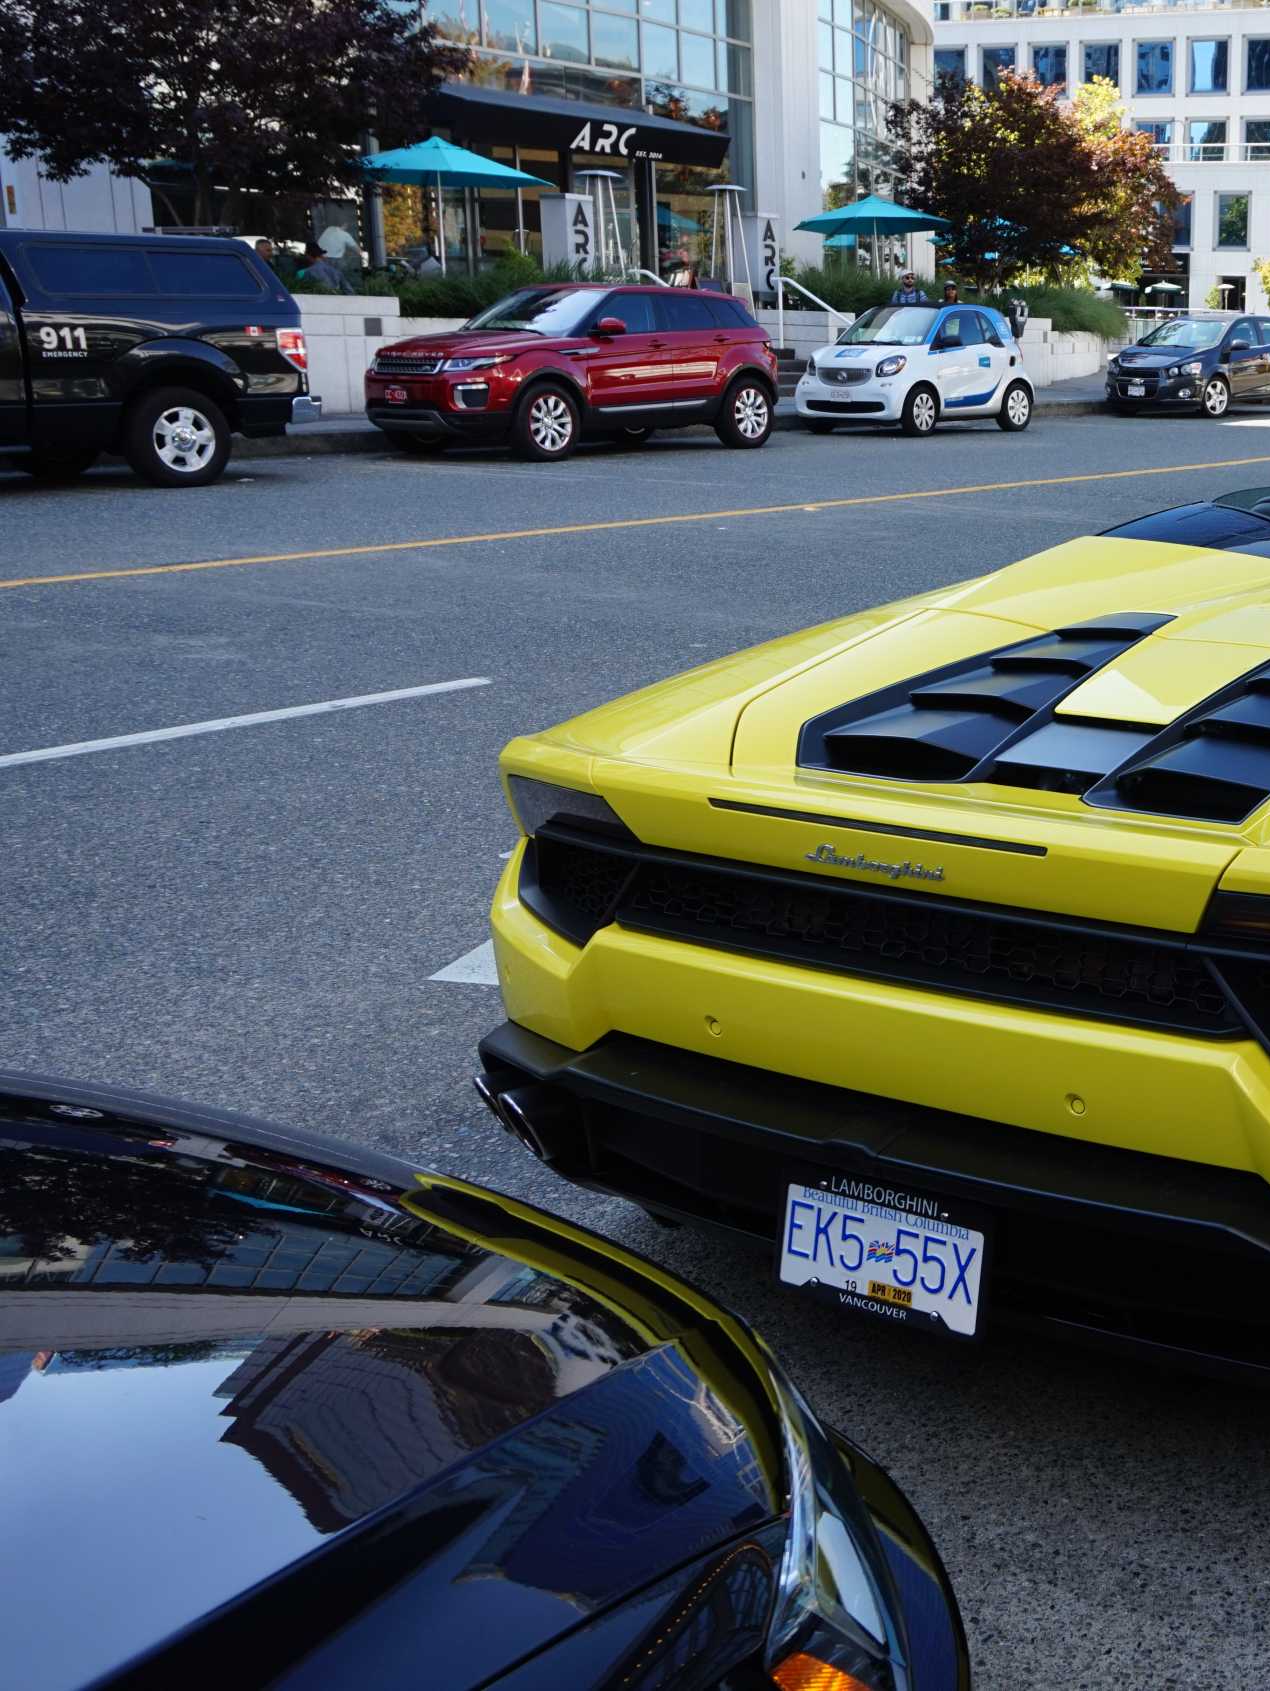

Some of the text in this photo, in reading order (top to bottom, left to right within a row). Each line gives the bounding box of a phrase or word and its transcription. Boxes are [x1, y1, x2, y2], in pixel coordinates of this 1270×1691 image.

[569, 121, 637, 156] ARC
[763, 219, 776, 291] ARC
[39, 326, 88, 350] 911
[805, 844, 945, 881] Lamborghini
[803, 1187, 970, 1241] Beautiful British Columbia
[831, 1176, 939, 1217] LAMBORGHINI
[787, 1200, 977, 1305] EK5 55X
[845, 1279, 857, 1293] 19
[871, 1283, 886, 1296] APR
[892, 1288, 912, 1303] 2020
[839, 1292, 907, 1320] VANCOUVER
